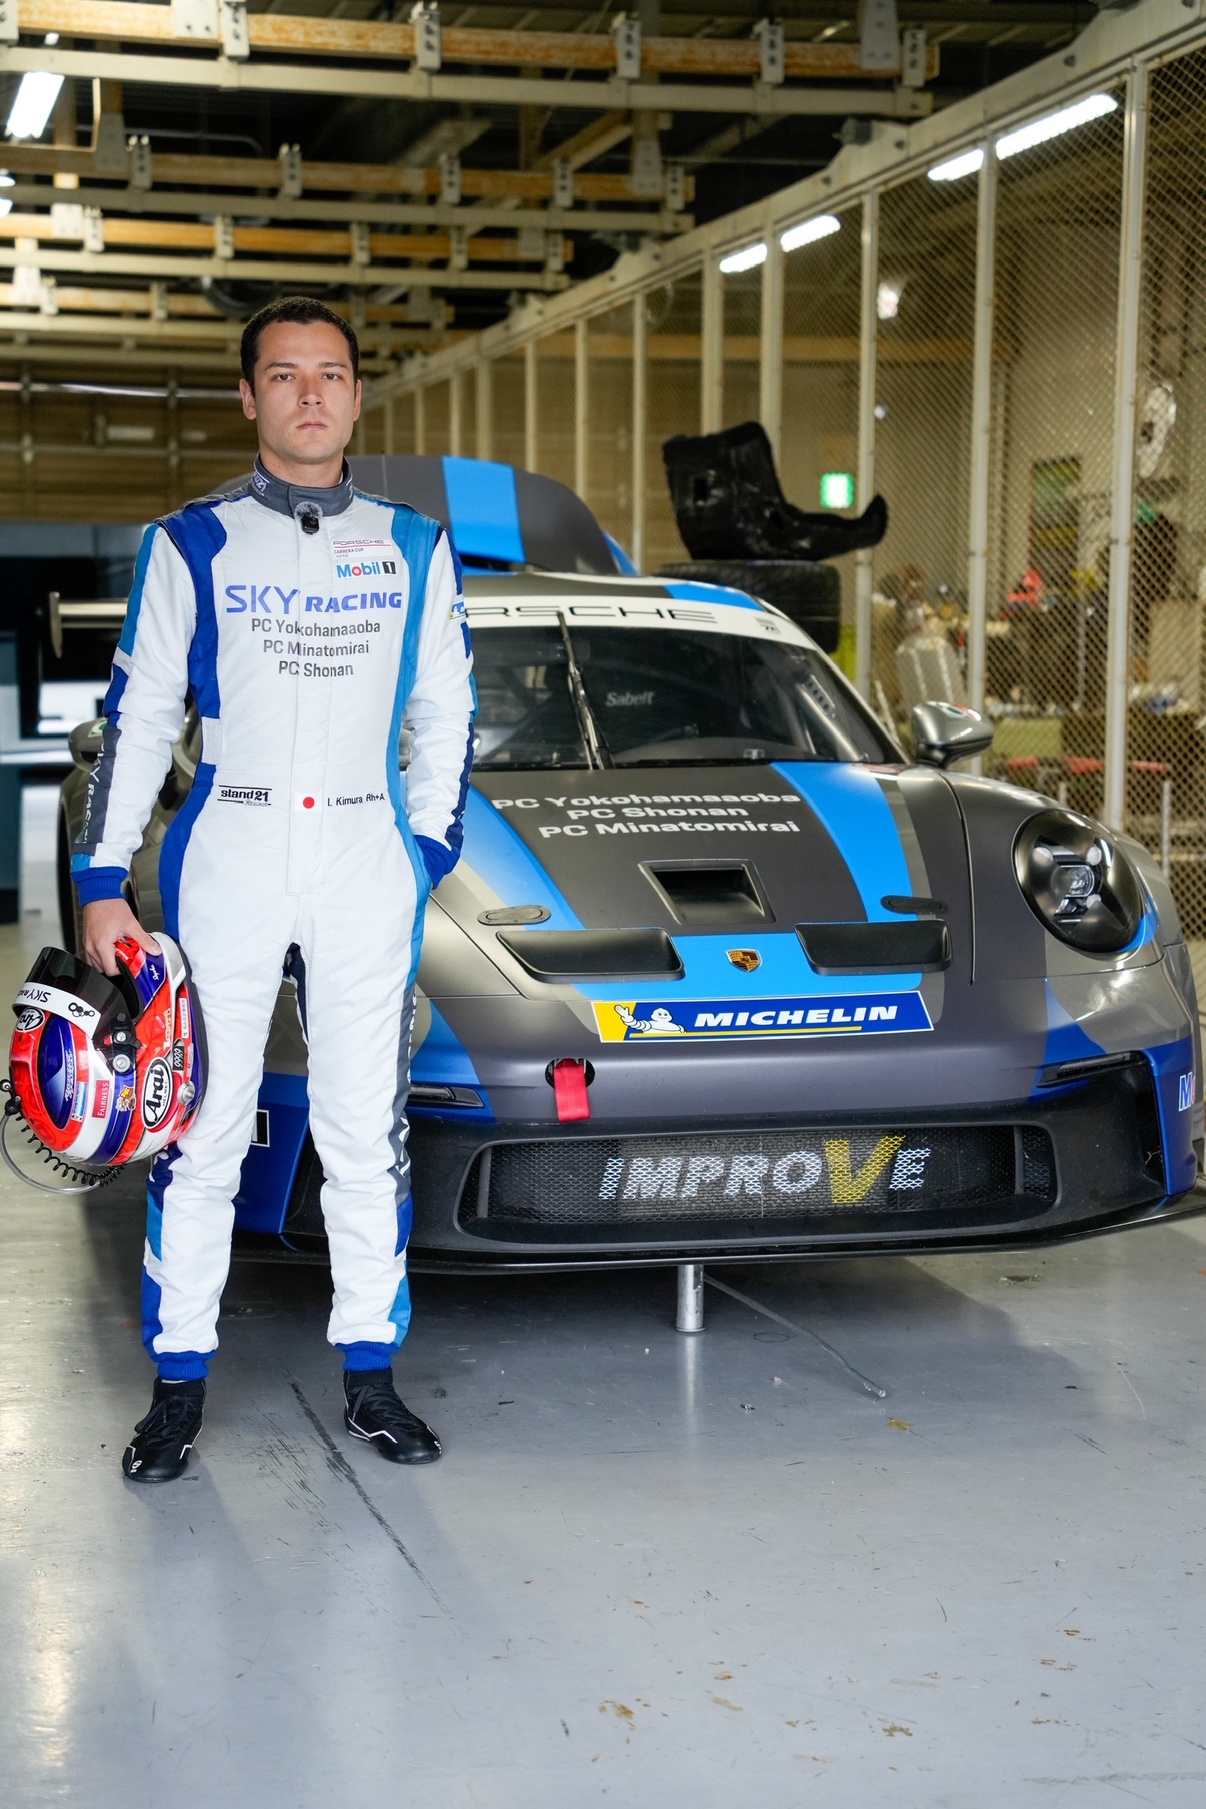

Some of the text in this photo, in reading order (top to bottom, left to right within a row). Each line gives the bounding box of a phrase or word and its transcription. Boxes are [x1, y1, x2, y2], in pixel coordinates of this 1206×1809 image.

[336, 561, 394, 578] Mobil 1
[225, 585, 402, 614] SKY RACING
[464, 605, 718, 624] RSCHE
[251, 618, 381, 637] PC Yokohamaaoba
[263, 640, 369, 657] PC Minatomirai
[278, 661, 354, 677] PC Shonan
[336, 796, 363, 806] Kimura
[491, 793, 801, 810] PC Yokohamaaoba
[566, 806, 749, 820] PC Shonan
[538, 820, 801, 838] PC Minatomirai
[27, 989, 51, 1003] SKY
[19, 1013, 42, 1029] Ara
[694, 1005, 898, 1028] MICHELIN
[97, 1082, 109, 1117] FAIRNESS
[146, 1067, 164, 1123] Arai
[599, 1135, 931, 1204] IMPROVE
